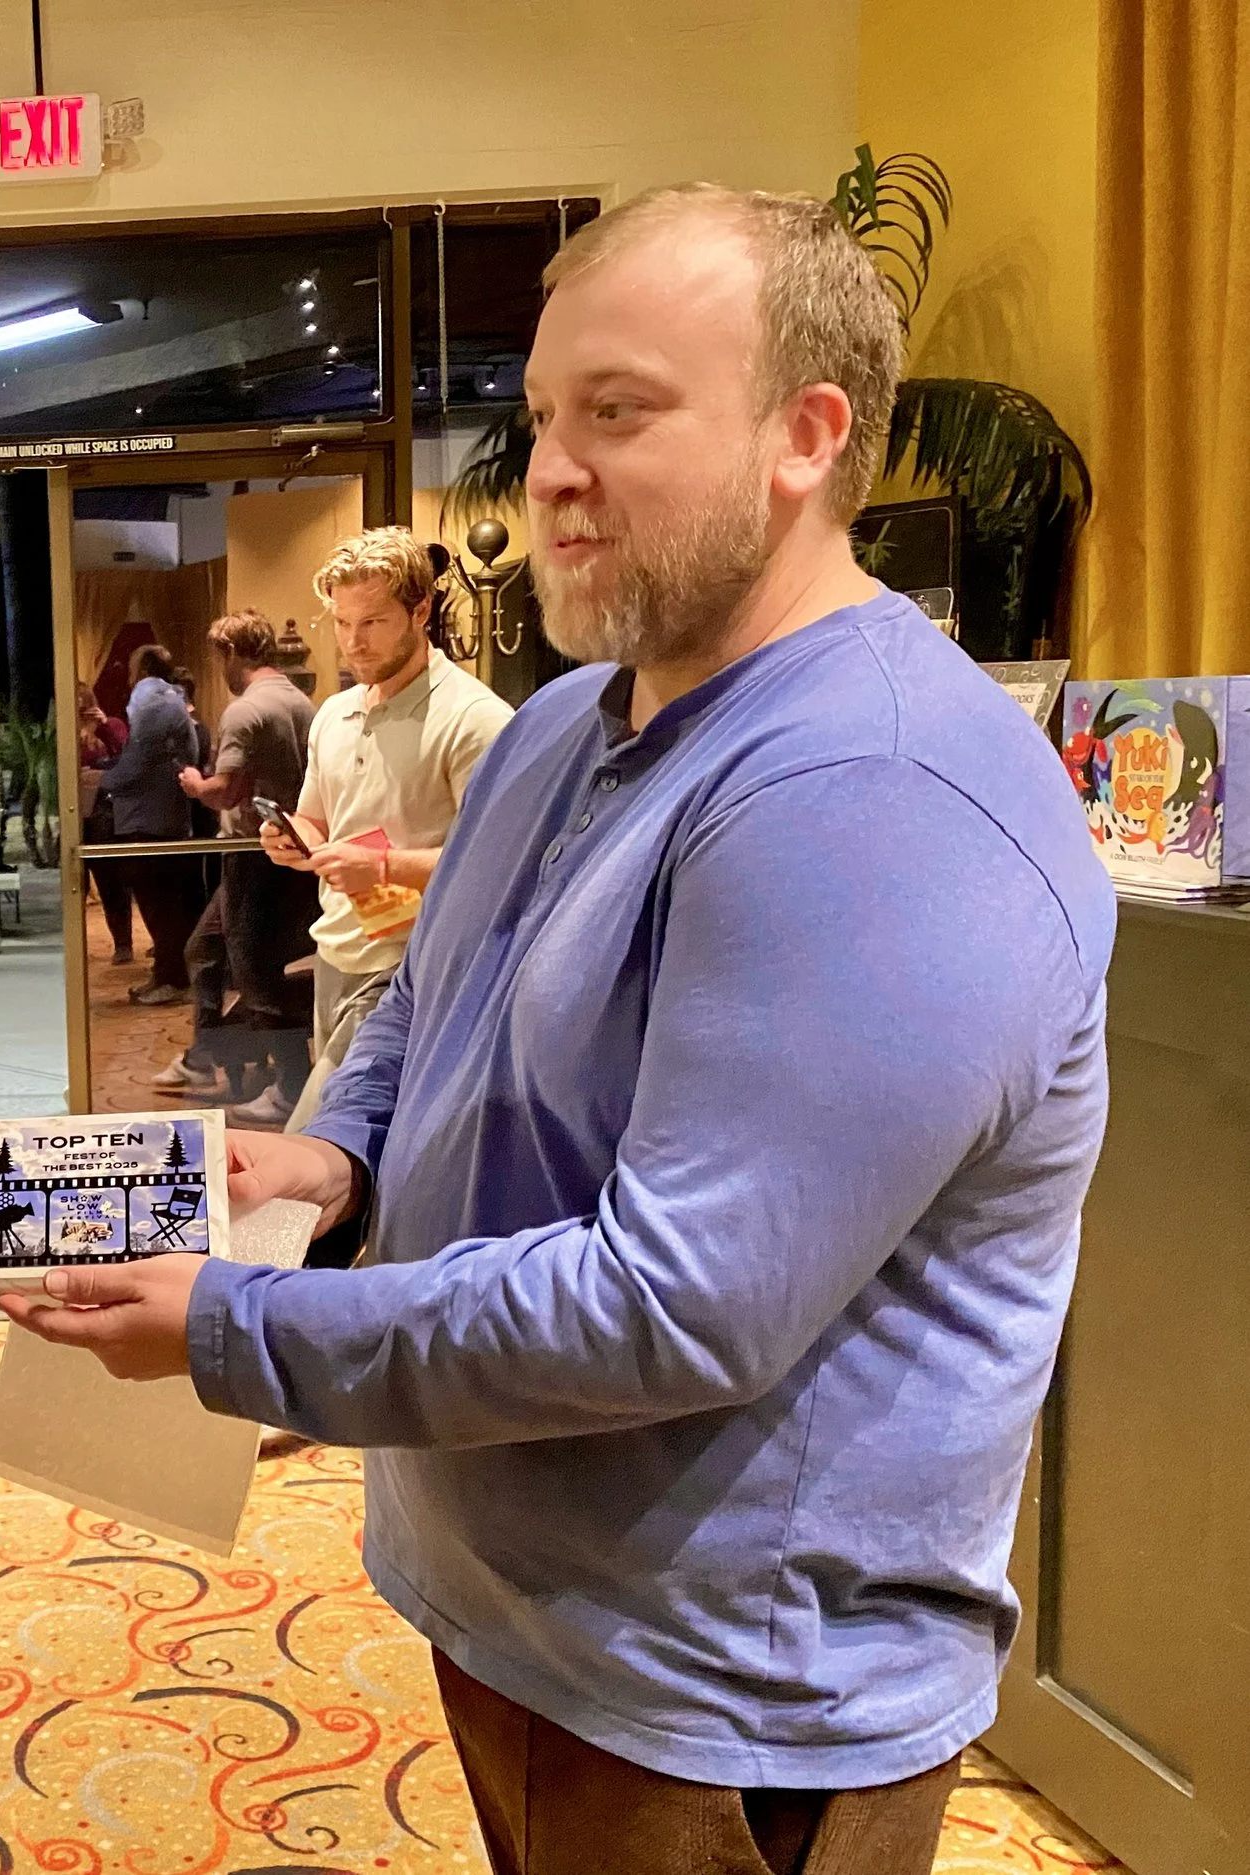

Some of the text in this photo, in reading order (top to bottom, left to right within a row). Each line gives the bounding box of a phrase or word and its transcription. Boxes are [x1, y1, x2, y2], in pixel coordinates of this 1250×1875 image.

[18, 444, 63, 457] UNLOCKED
[64, 442, 91, 455] WHILE
[92, 440, 119, 453] SPACE
[120, 440, 129, 452] IS
[130, 437, 173, 451] OCCUPIED
[32, 1132, 144, 1149] TOP TEN
[64, 1151, 116, 1160] FEST OF
[42, 1164, 67, 1172] THE
[69, 1163, 103, 1171] BEST
[60, 1194, 102, 1203] SHOW
[67, 1203, 99, 1211] LOW
